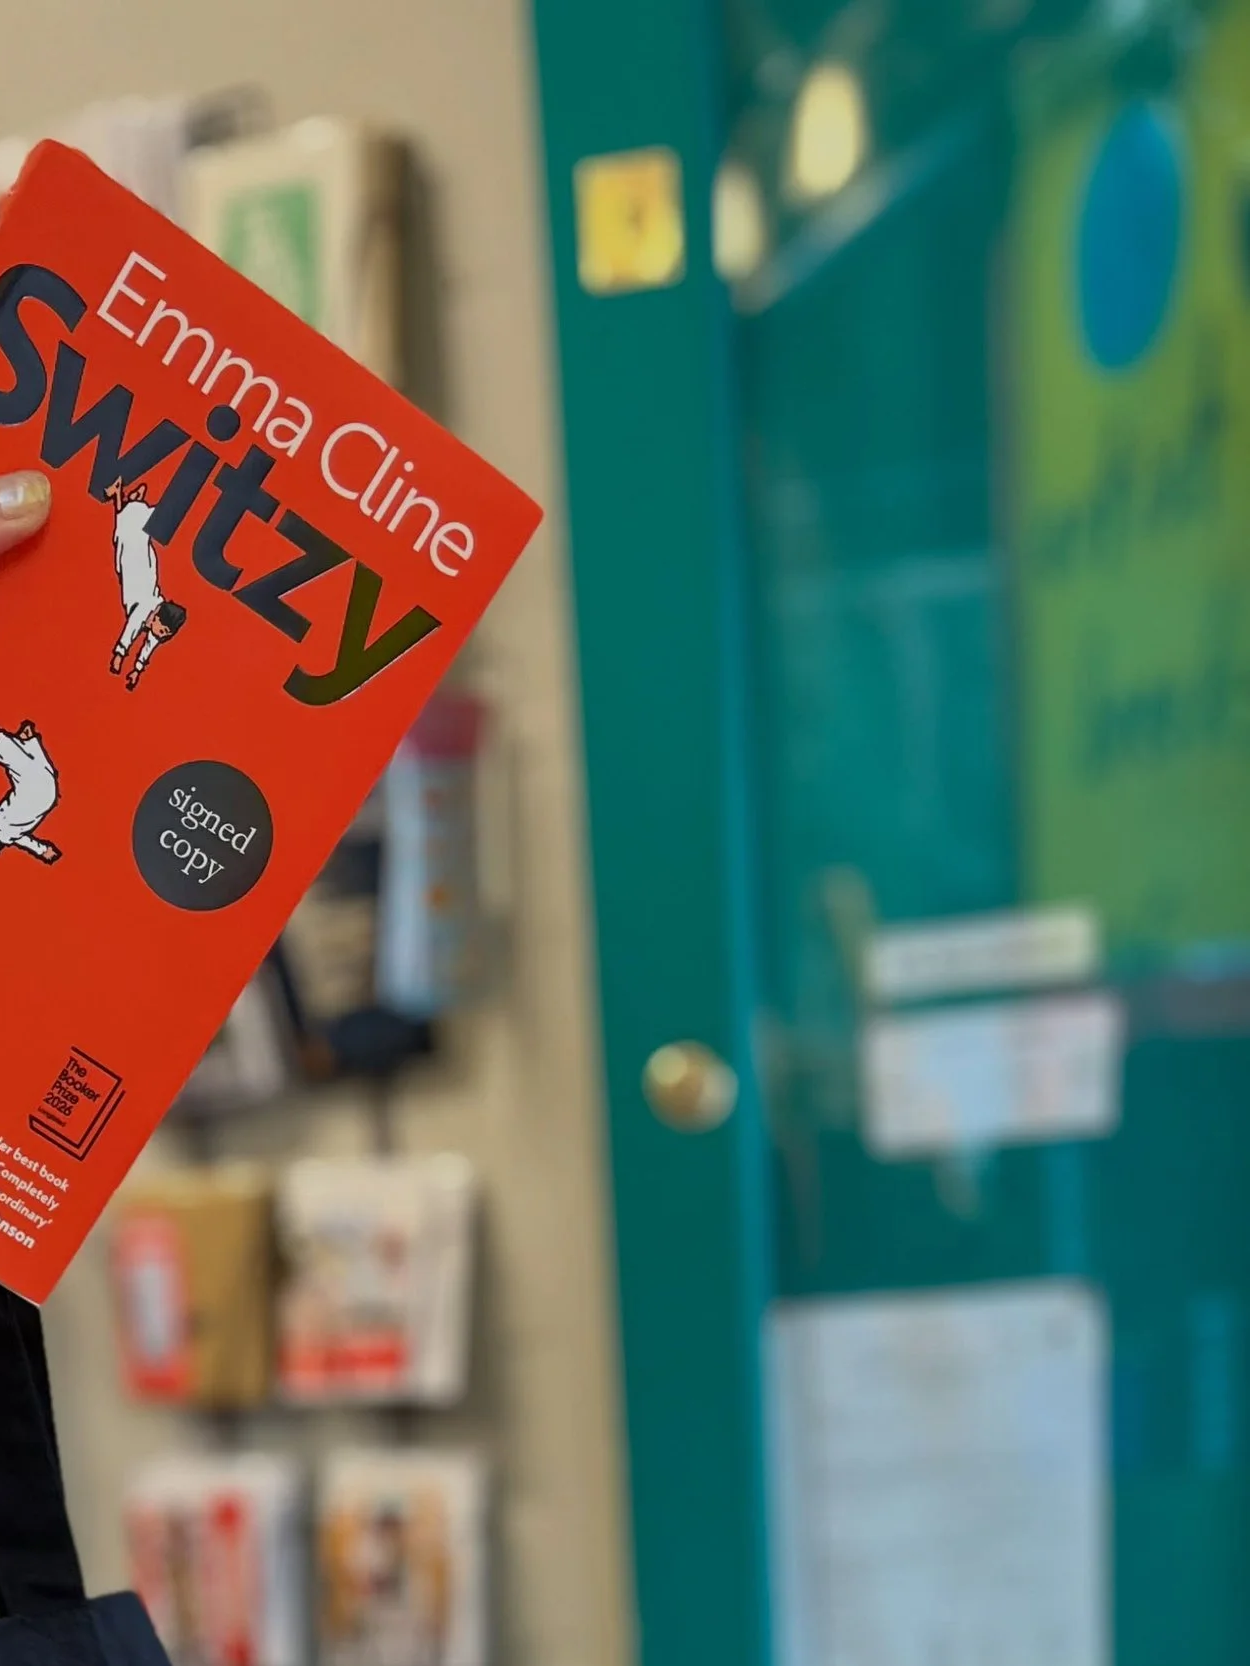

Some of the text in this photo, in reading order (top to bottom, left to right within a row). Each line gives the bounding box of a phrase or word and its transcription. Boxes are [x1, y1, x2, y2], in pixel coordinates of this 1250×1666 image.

[96, 251, 475, 577] Emma Cline
[168, 786, 257, 854] signed
[160, 830, 225, 883] copy
[58, 1068, 100, 1102] Booker
[66, 1056, 87, 1078] The
[43, 1092, 74, 1116] 2026
[51, 1080, 79, 1105] Prize
[13, 1147, 39, 1172] best
[39, 1165, 69, 1192] book
